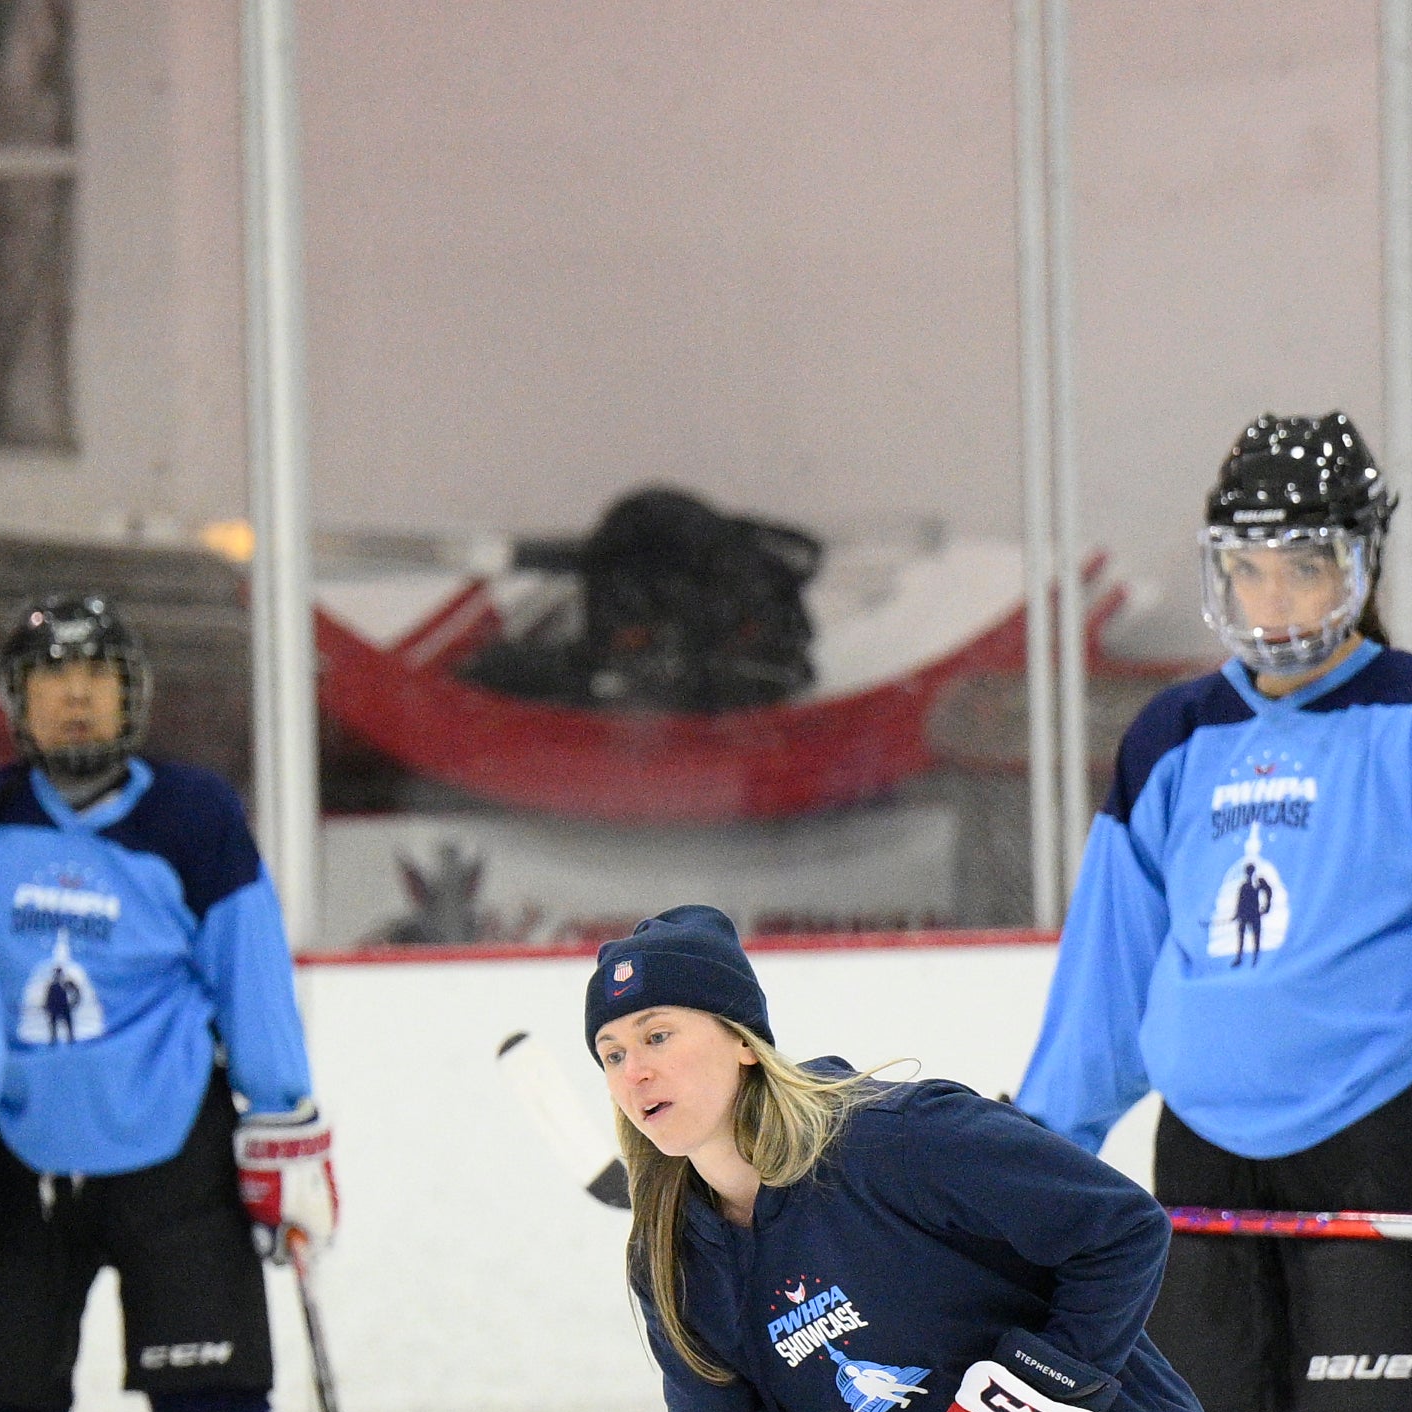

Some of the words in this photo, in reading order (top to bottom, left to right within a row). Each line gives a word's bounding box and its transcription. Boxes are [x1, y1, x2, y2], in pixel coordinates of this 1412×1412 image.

[767, 1285, 849, 1343] PWHPA
[774, 1301, 869, 1368] SHOWCASE
[1014, 1349, 1076, 1389] STEPHENSON
